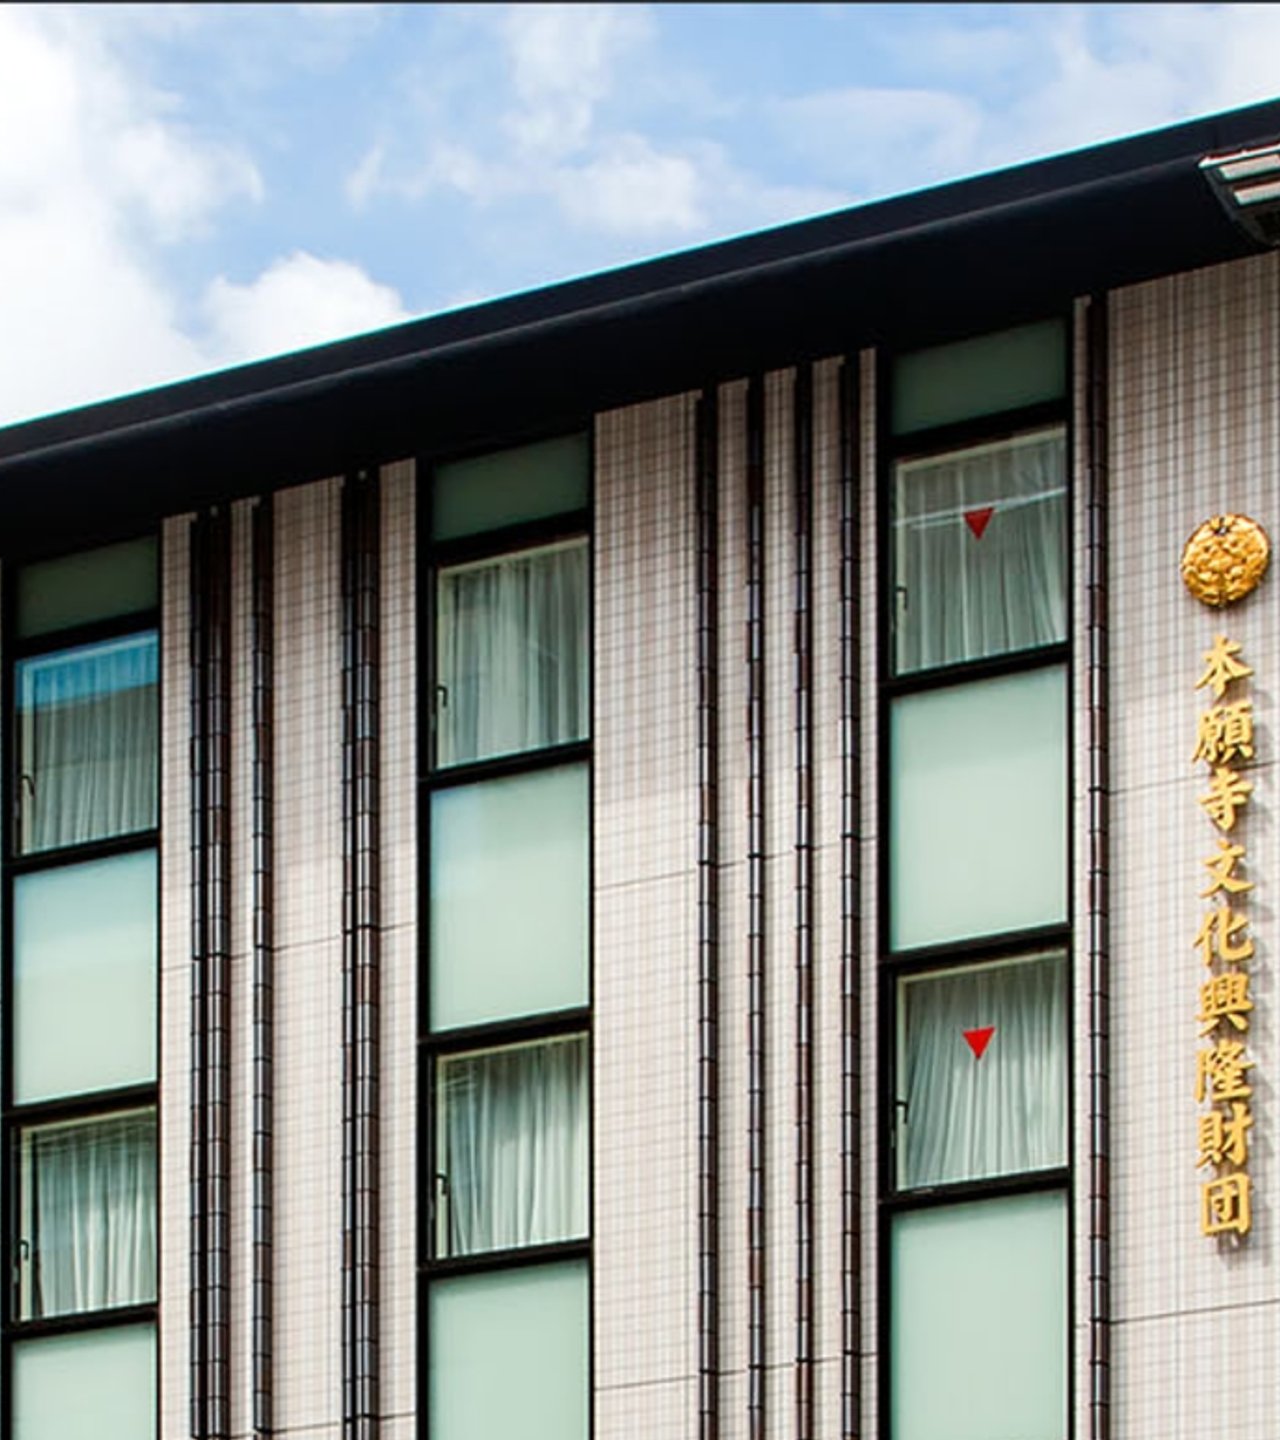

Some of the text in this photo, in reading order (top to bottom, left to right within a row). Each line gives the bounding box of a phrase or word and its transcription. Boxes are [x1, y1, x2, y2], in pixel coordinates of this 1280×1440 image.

[1192, 634, 1255, 1238] 本願寺文化興隆財団
